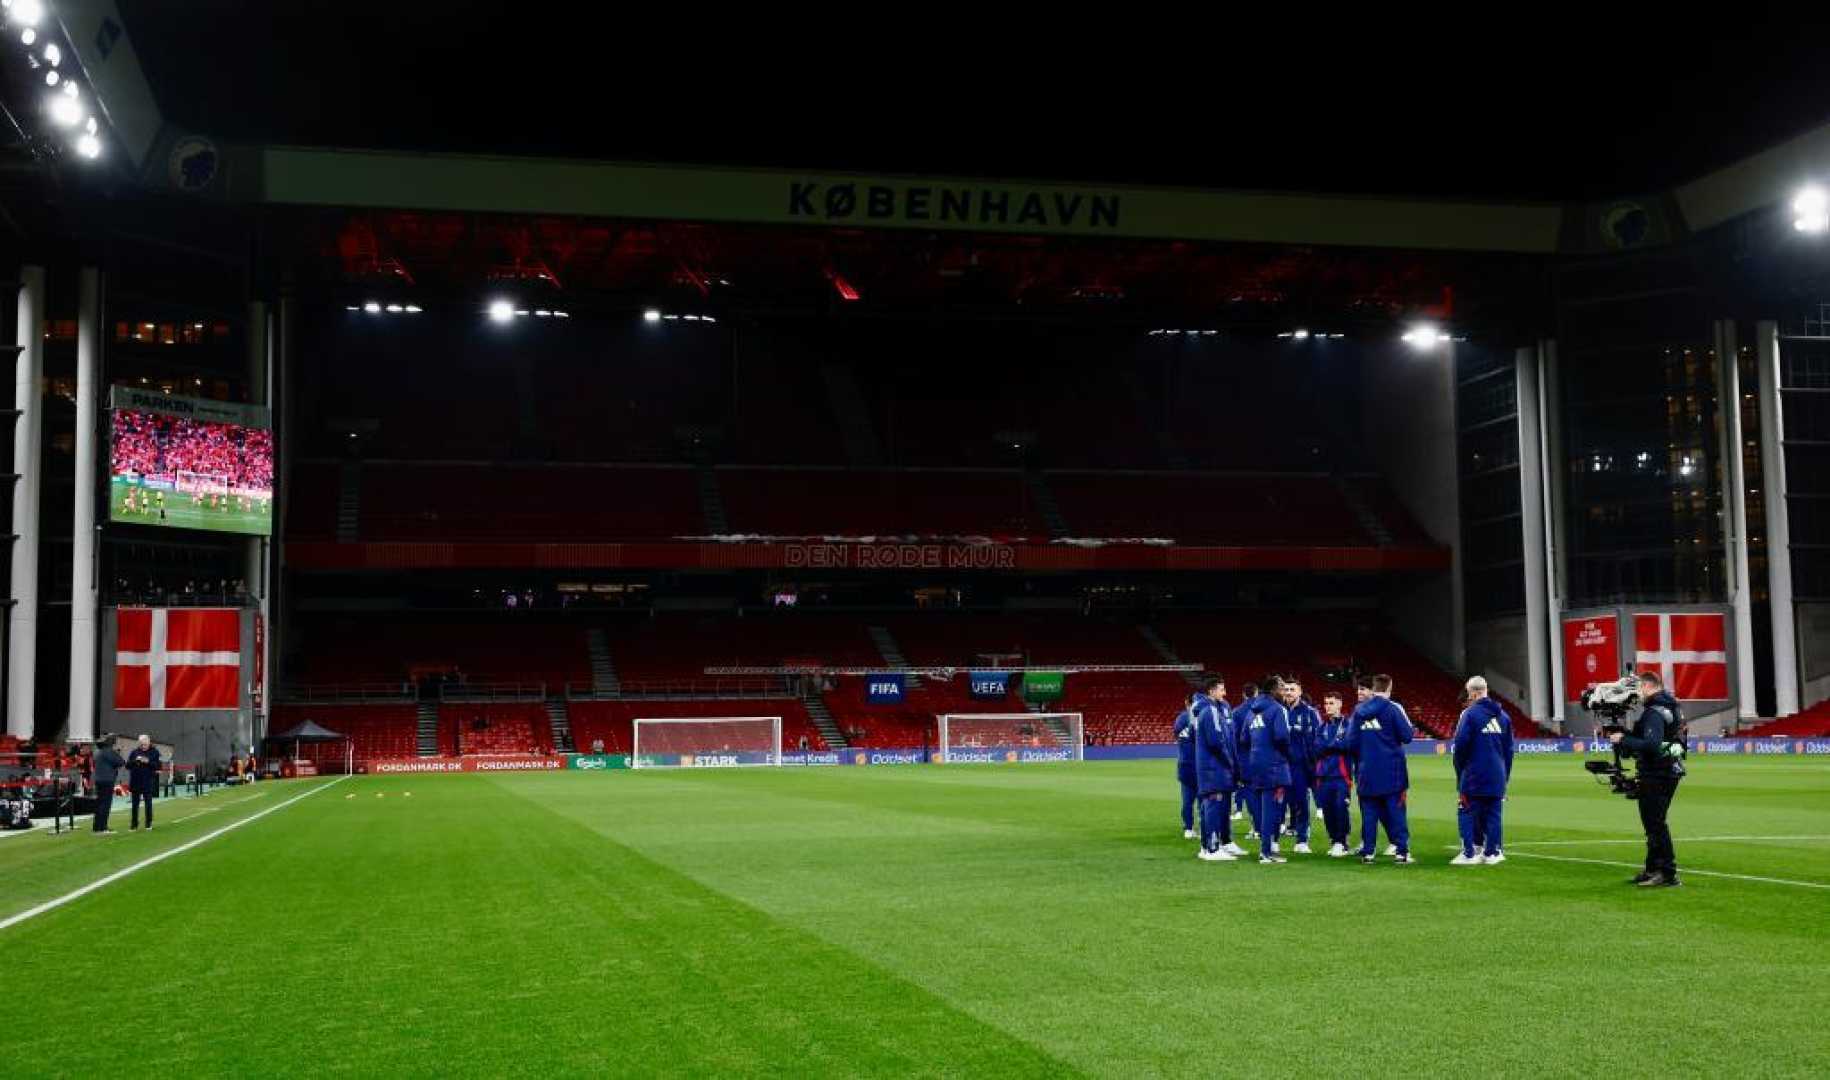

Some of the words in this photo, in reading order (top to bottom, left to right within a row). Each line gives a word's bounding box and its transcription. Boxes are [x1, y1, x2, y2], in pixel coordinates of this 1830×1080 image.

[788, 182, 1121, 227] KØBENHAVN
[784, 544, 848, 568] DEN
[857, 544, 942, 568] RØDE
[951, 544, 1015, 568] MUR
[870, 683, 899, 695] FIFA
[972, 682, 1006, 695] UEFA
[694, 756, 738, 768] STARK
